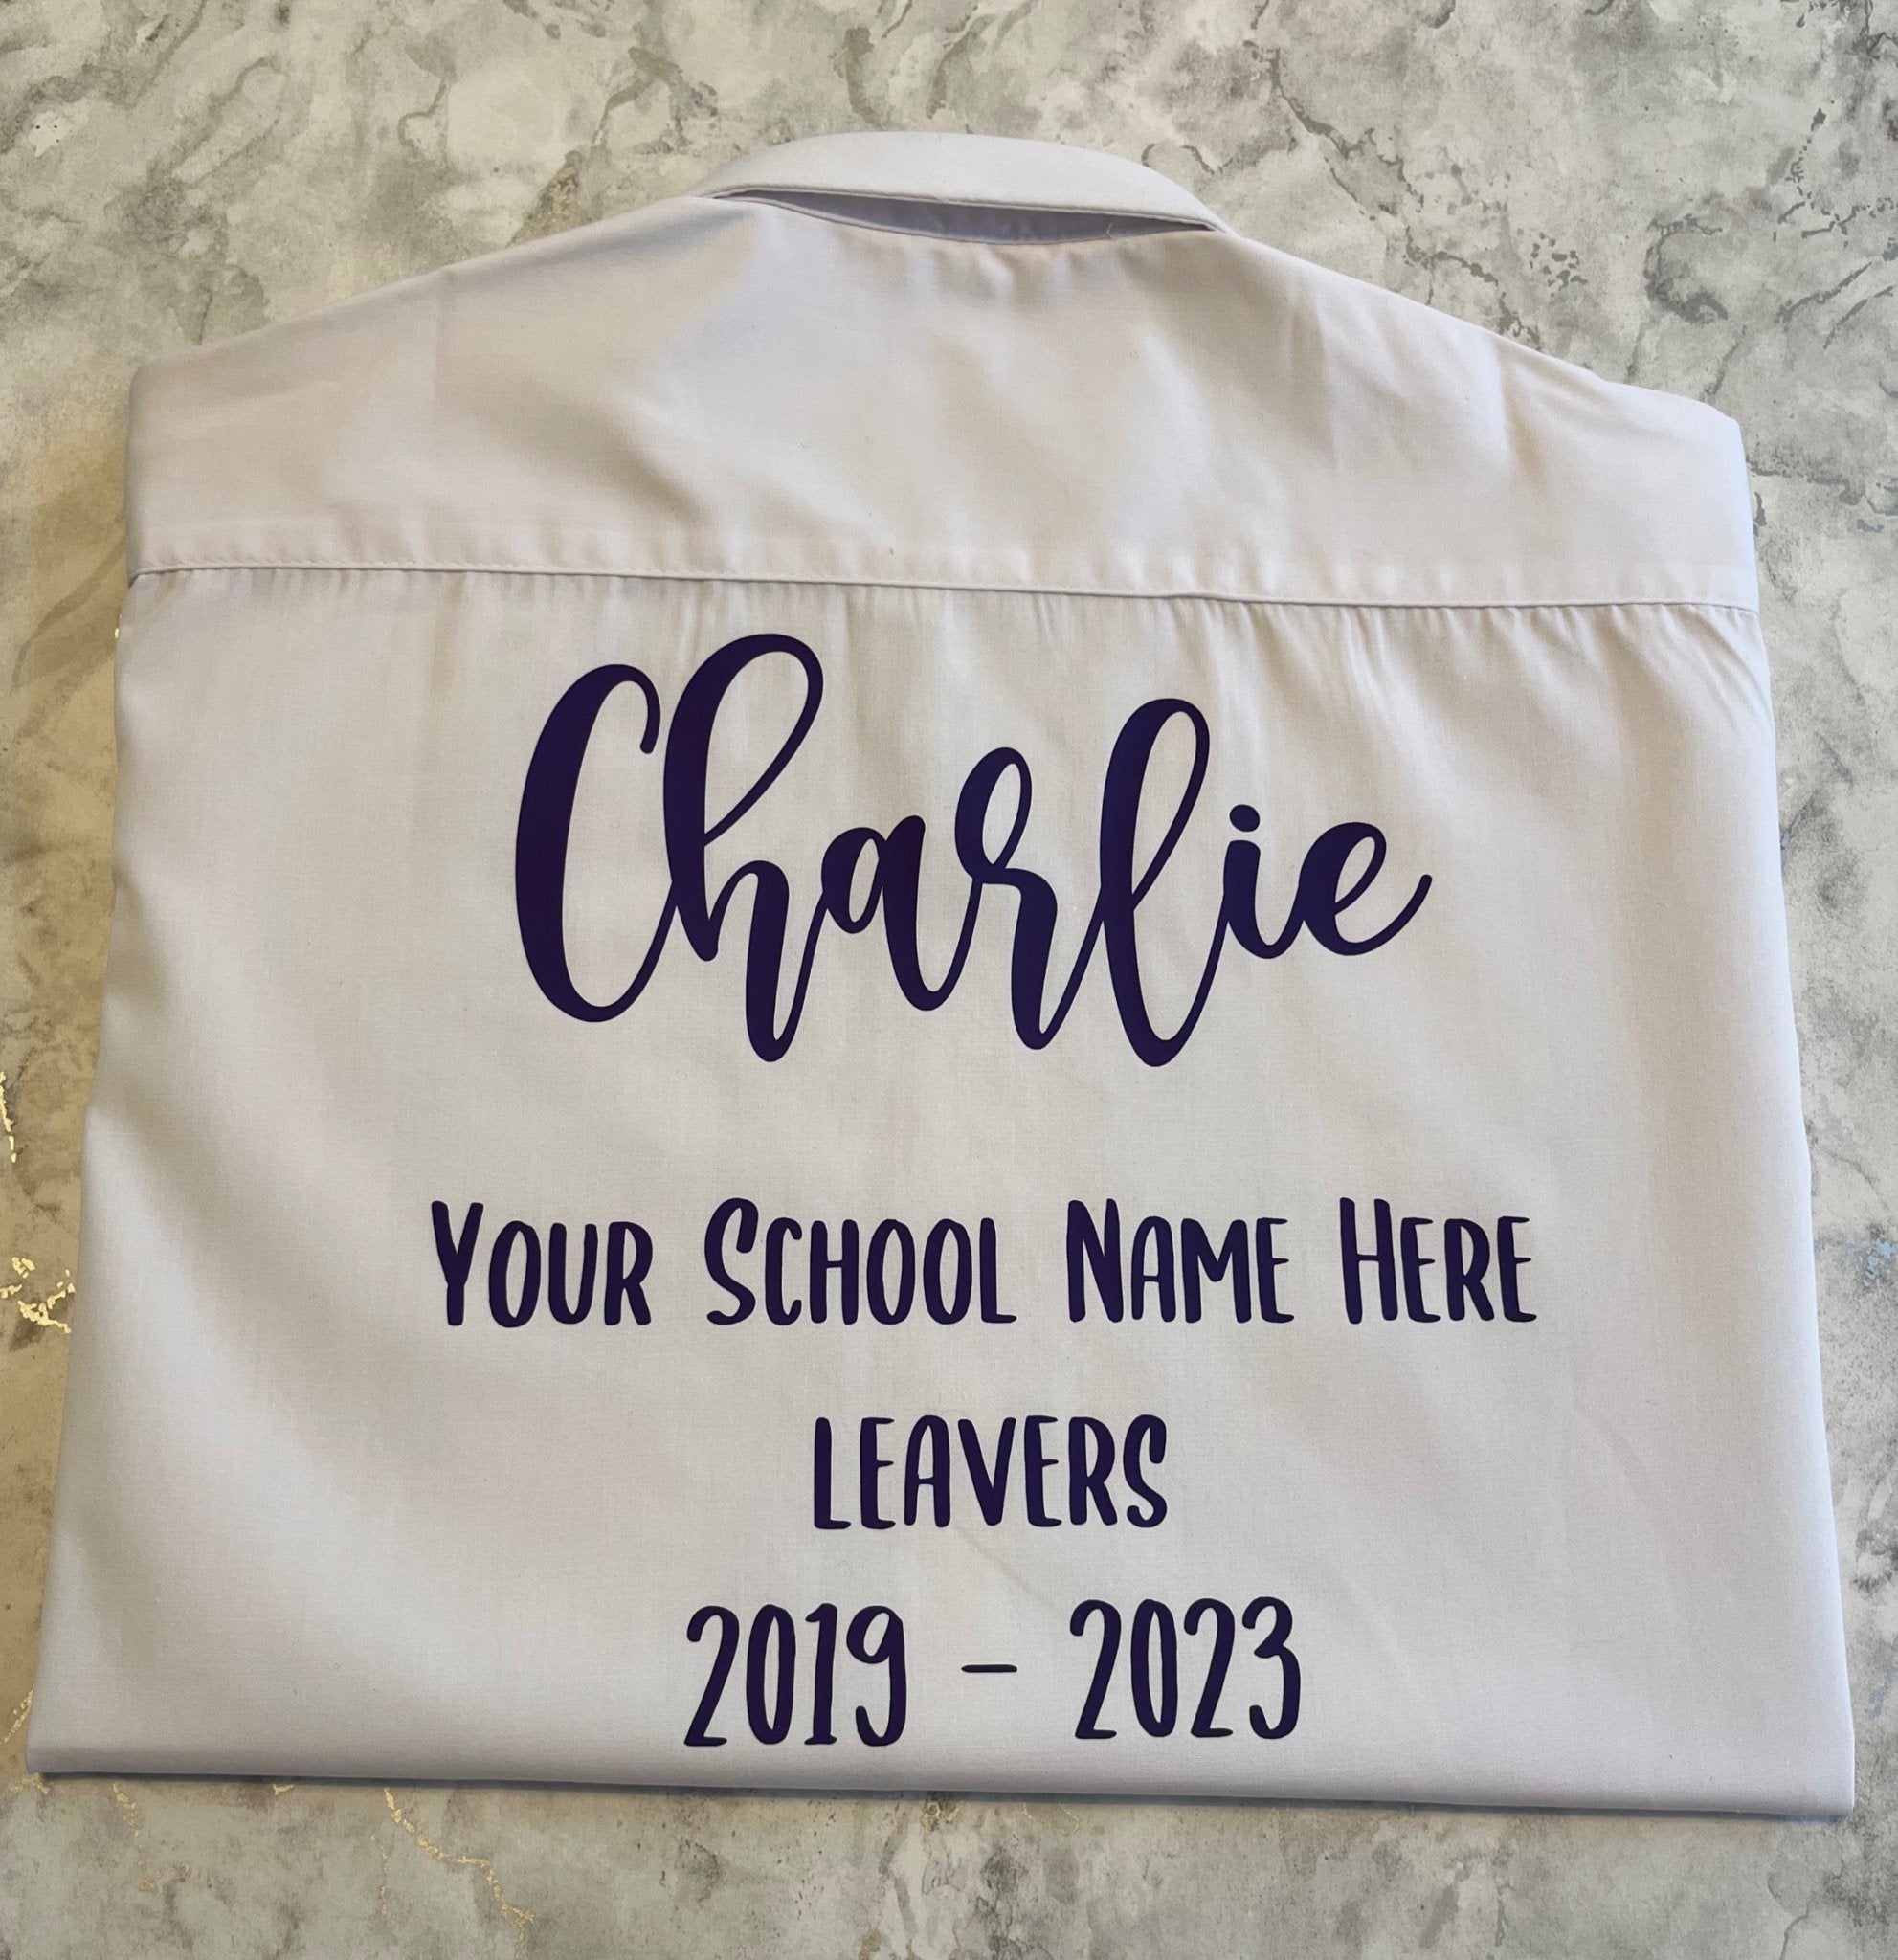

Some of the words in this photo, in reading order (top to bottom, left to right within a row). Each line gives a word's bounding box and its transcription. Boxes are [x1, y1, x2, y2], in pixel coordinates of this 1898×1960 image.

[514, 633, 1434, 1068] Charlie
[813, 1414, 1169, 1530] LEAVERS
[683, 1604, 908, 1748] 2019
[1068, 1596, 1302, 1741] 2023
